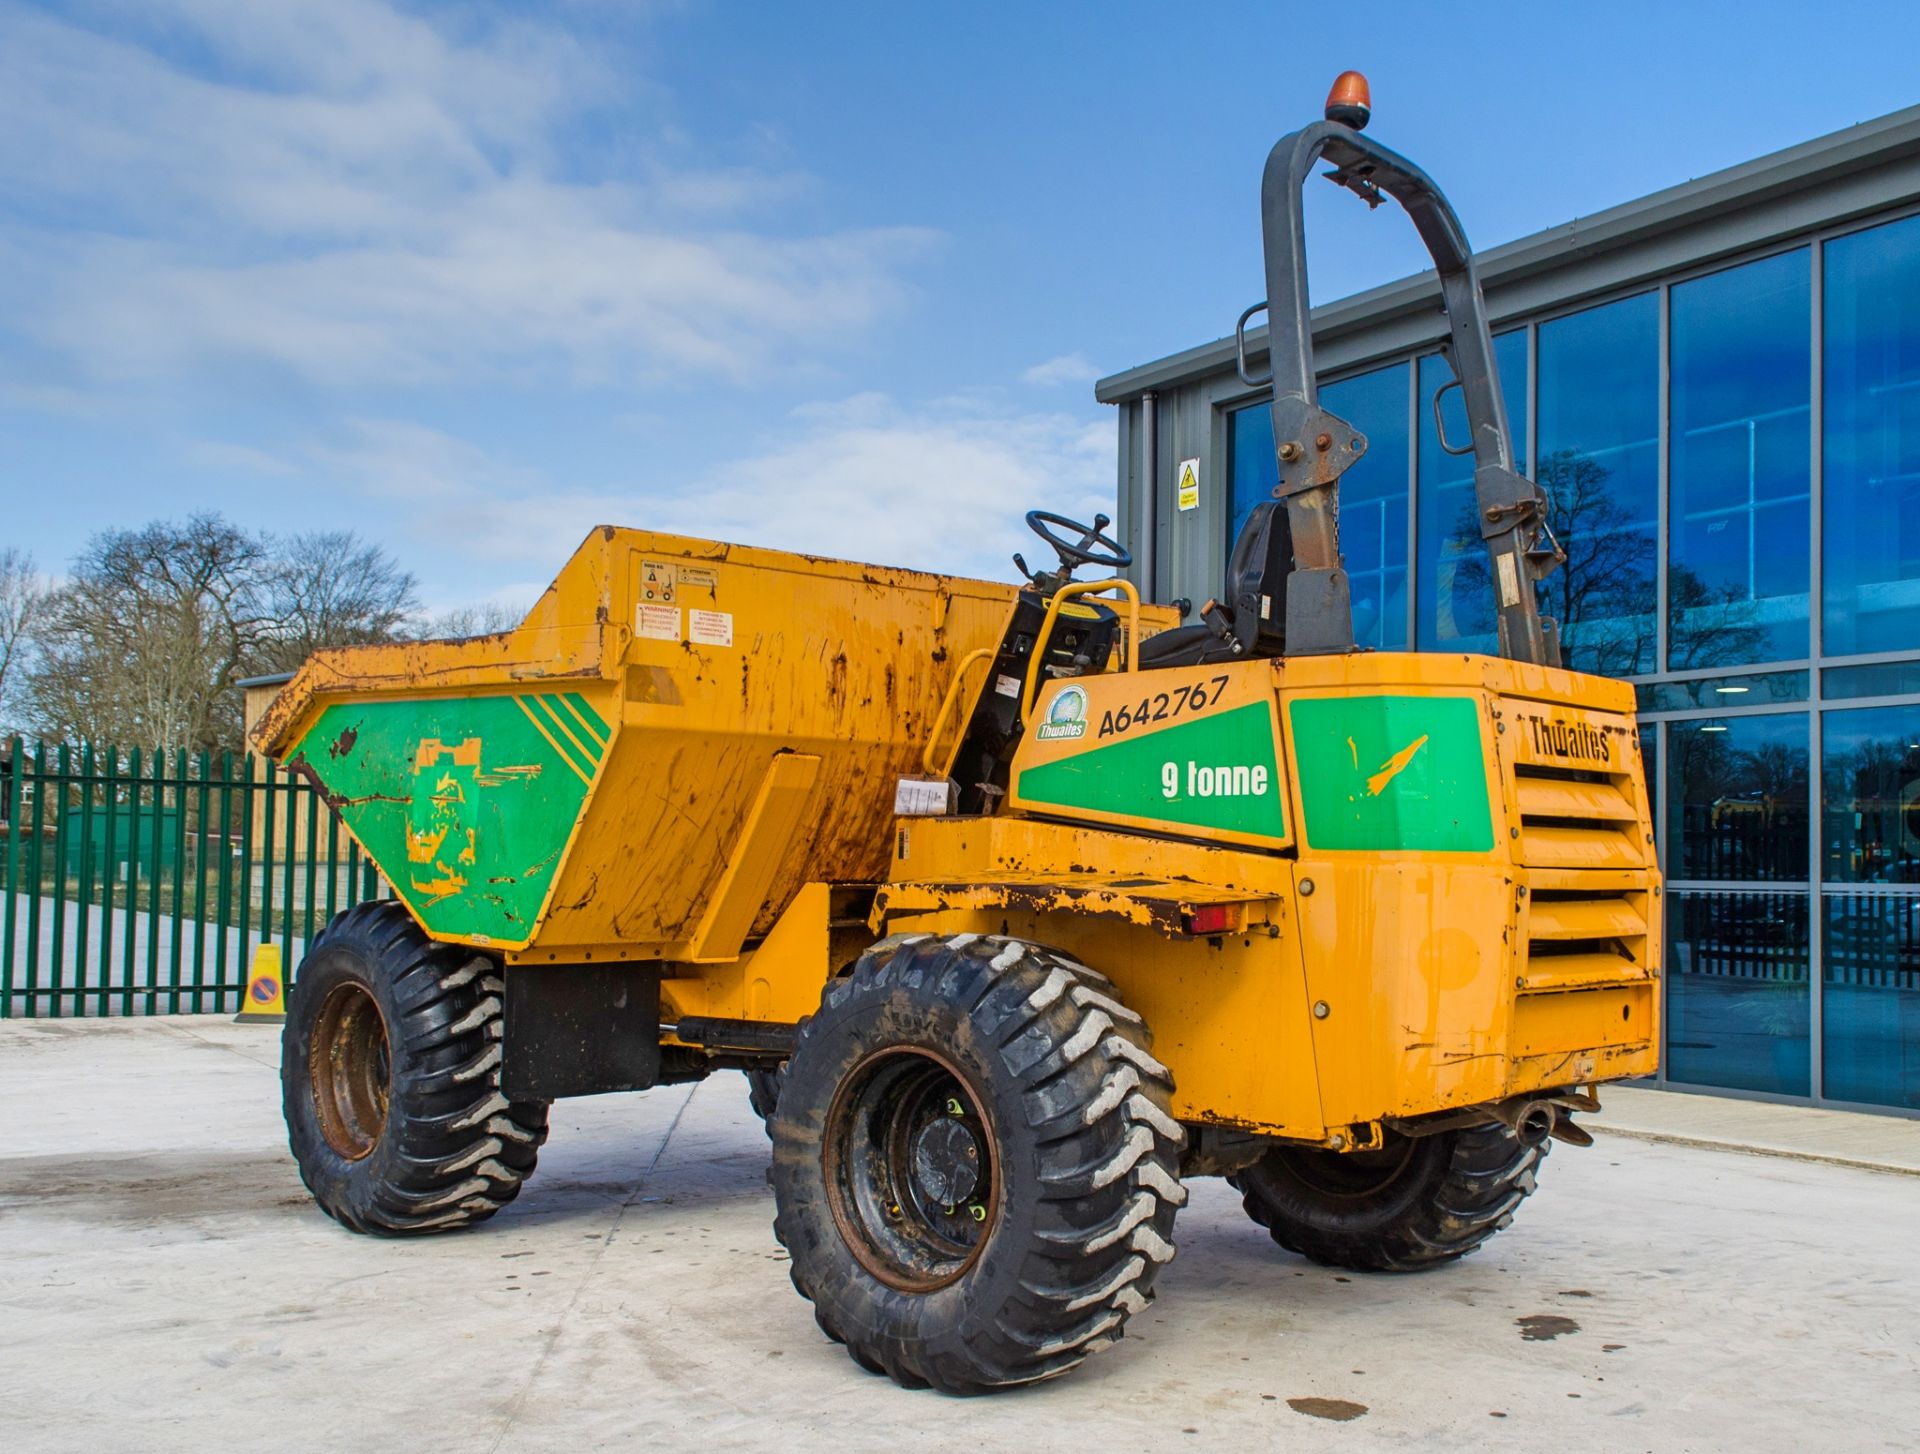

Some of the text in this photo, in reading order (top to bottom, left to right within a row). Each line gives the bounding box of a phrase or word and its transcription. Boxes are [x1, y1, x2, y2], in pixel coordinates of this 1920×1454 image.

[1098, 675, 1229, 739] A642767
[1040, 723, 1083, 738] Thwaites
[1529, 715, 1609, 762] Thwaites
[1161, 760, 1268, 798] 9 tonne
